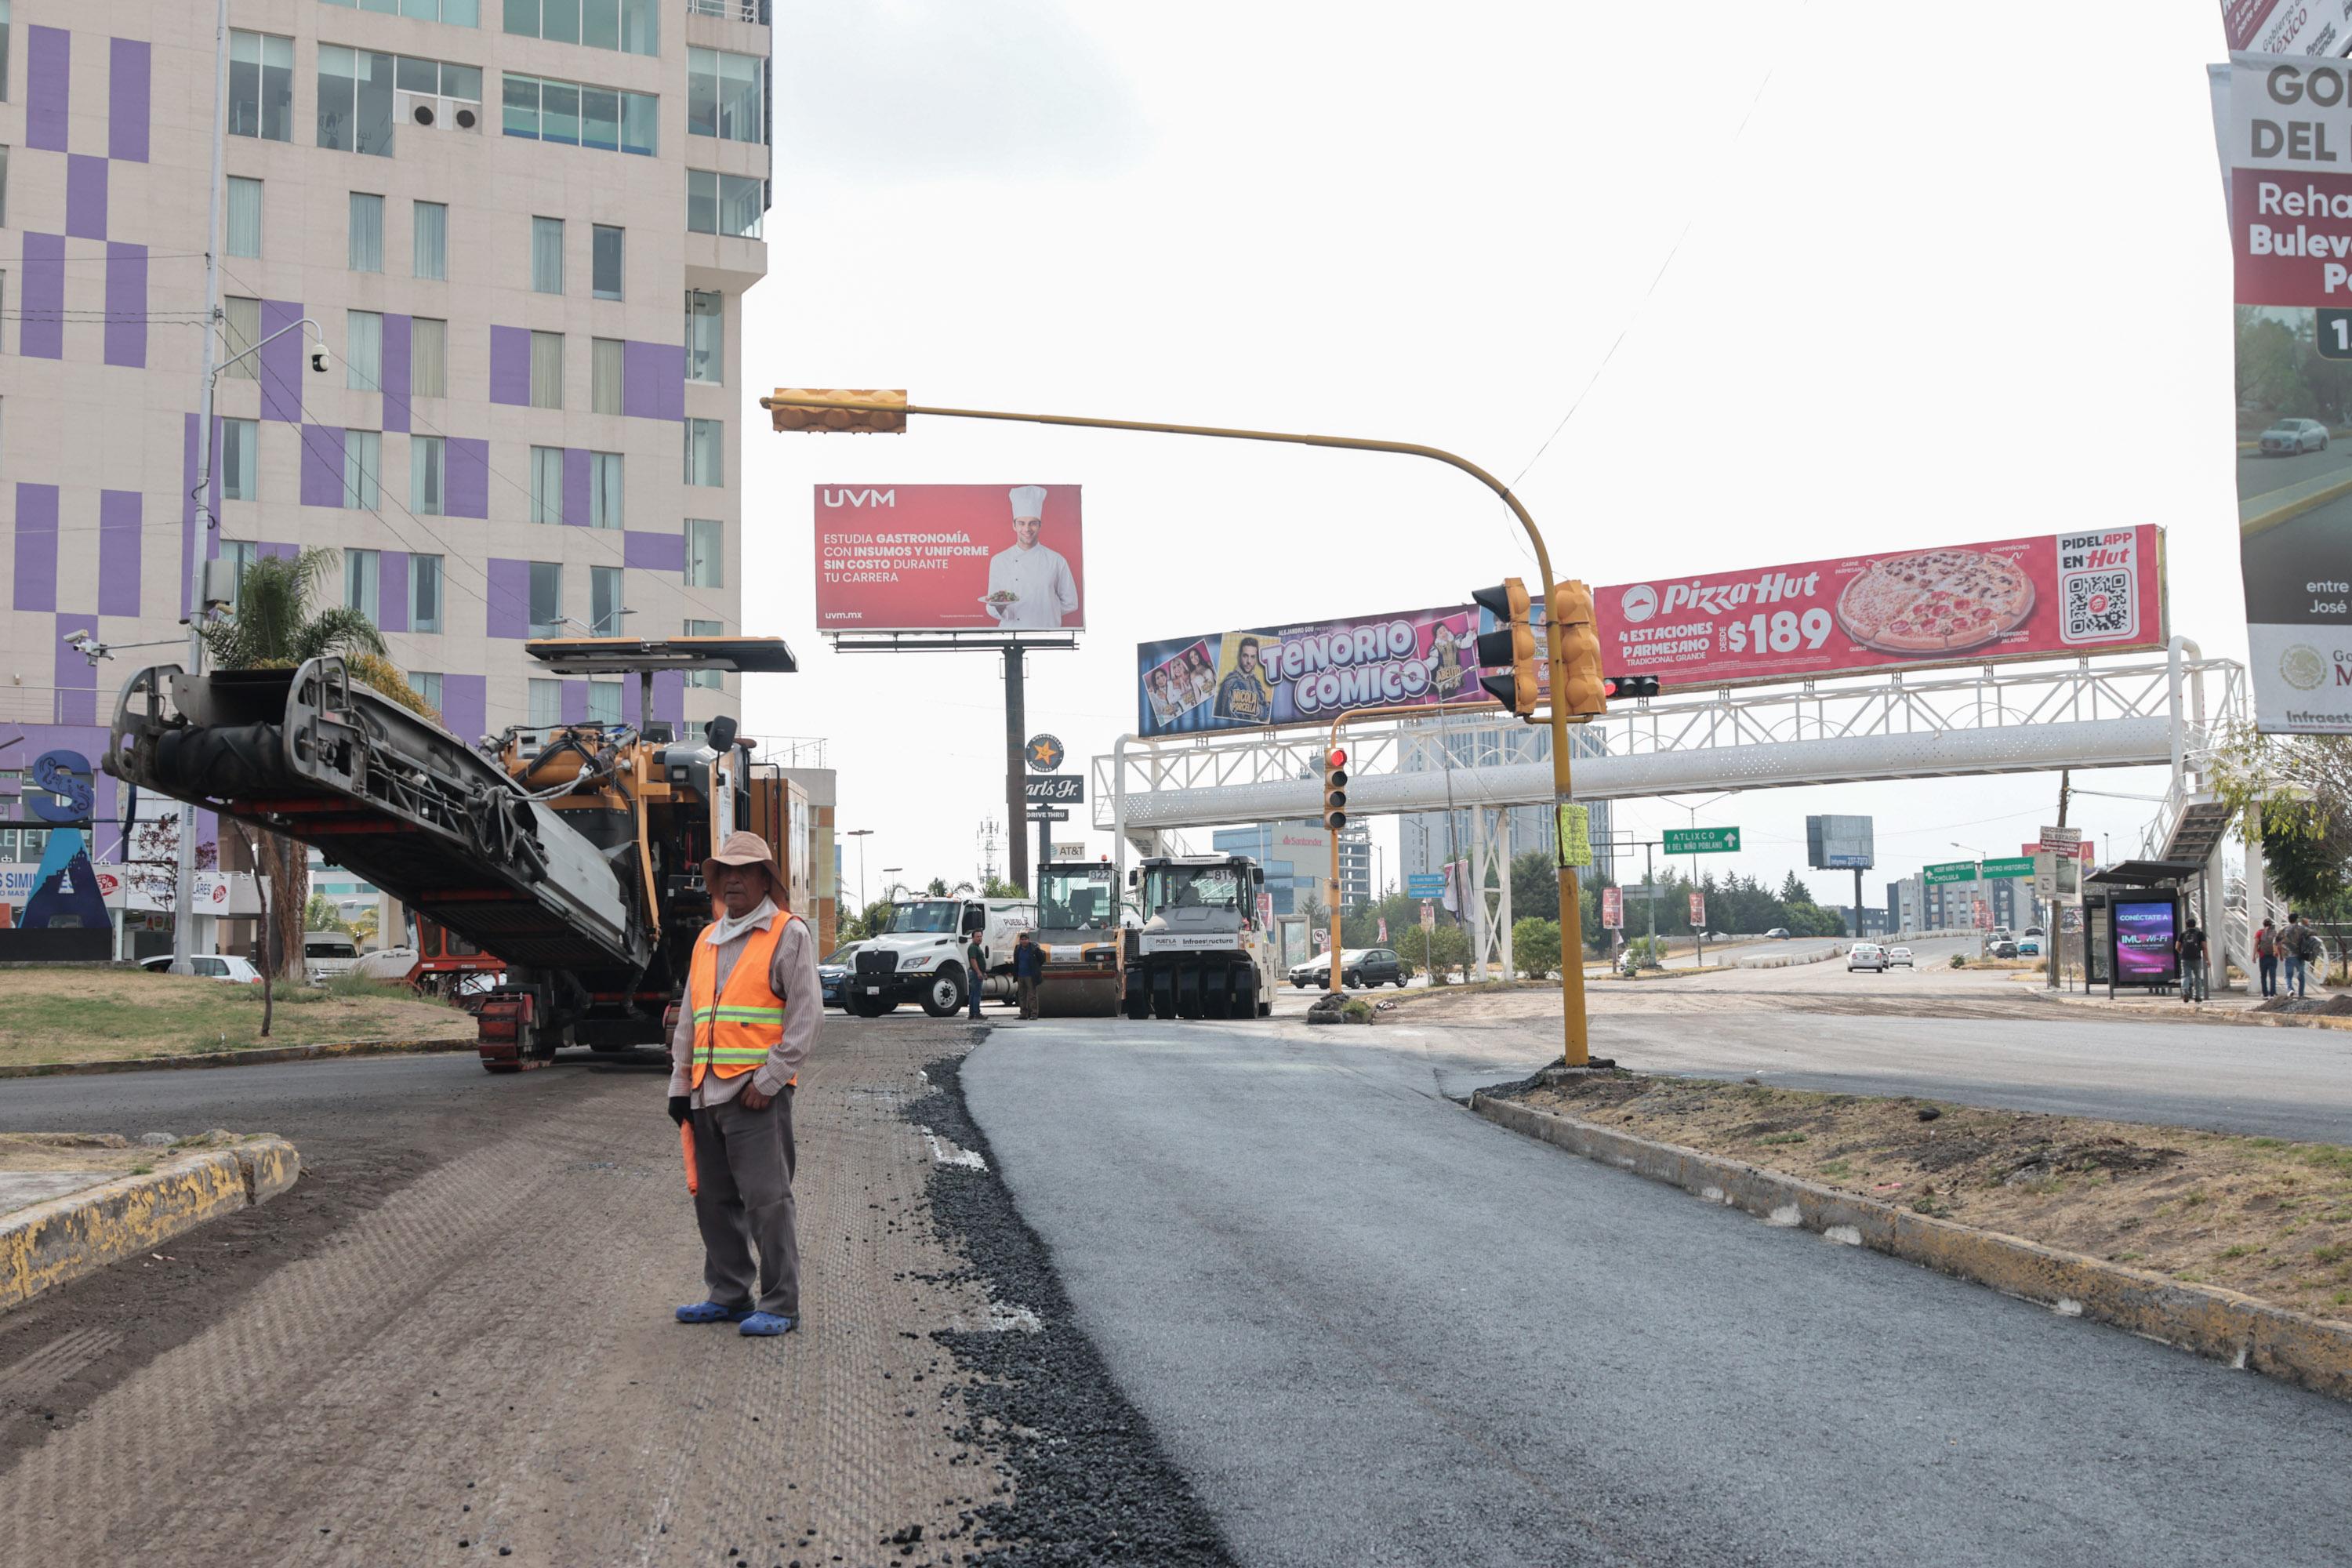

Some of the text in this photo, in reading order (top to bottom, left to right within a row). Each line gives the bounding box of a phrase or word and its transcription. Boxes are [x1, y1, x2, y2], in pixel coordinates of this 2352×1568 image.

[2263, 5, 2295, 53] Gobierno
[2267, 64, 2352, 108] GO
[2251, 118, 2337, 162] DEL
[2249, 223, 2352, 259] Bulev
[2324, 263, 2352, 293] P
[2330, 318, 2352, 350] 1
[824, 489, 895, 508] UVM
[824, 530, 971, 544] ESTUDIA GASTRONOMÍA
[824, 546, 989, 557] CON INSUMOS Y UNIFORME
[2063, 548, 2131, 568] EN Hut
[824, 559, 949, 570] SIN COSTO DURANTE
[824, 572, 899, 583] TU CARRERA
[1661, 572, 1820, 615] Pizza Hut
[2306, 582, 2350, 593] entre
[2309, 600, 2347, 614] José
[1278, 626, 1305, 637] ALEJANDRO
[1618, 622, 1714, 644] 4 ESTACIONES
[1727, 608, 1833, 655] $189
[1622, 637, 1711, 659] PARMESANO
[1625, 654, 1674, 666] TRADICIONAL
[1675, 652, 1707, 662] GRANDE
[1296, 659, 1430, 712] CÓMICO
[1232, 689, 1259, 702] NICOLA
[2286, 710, 2352, 724] Infraest
[1029, 760, 1053, 772] BURGERS
[1025, 779, 1054, 797] arl's
[1291, 837, 1323, 847] Santander
[1673, 832, 1715, 841] ATLIXCO
[1059, 846, 1085, 856] AT&T
[1671, 843, 1682, 851] DEL
[1683, 841, 1697, 851] NIÑO
[1697, 840, 1723, 850] POBLANO
[1091, 870, 1111, 880] 822
[1934, 873, 1960, 882] CHOLULA
[1004, 918, 1030, 927] PUEBLA
